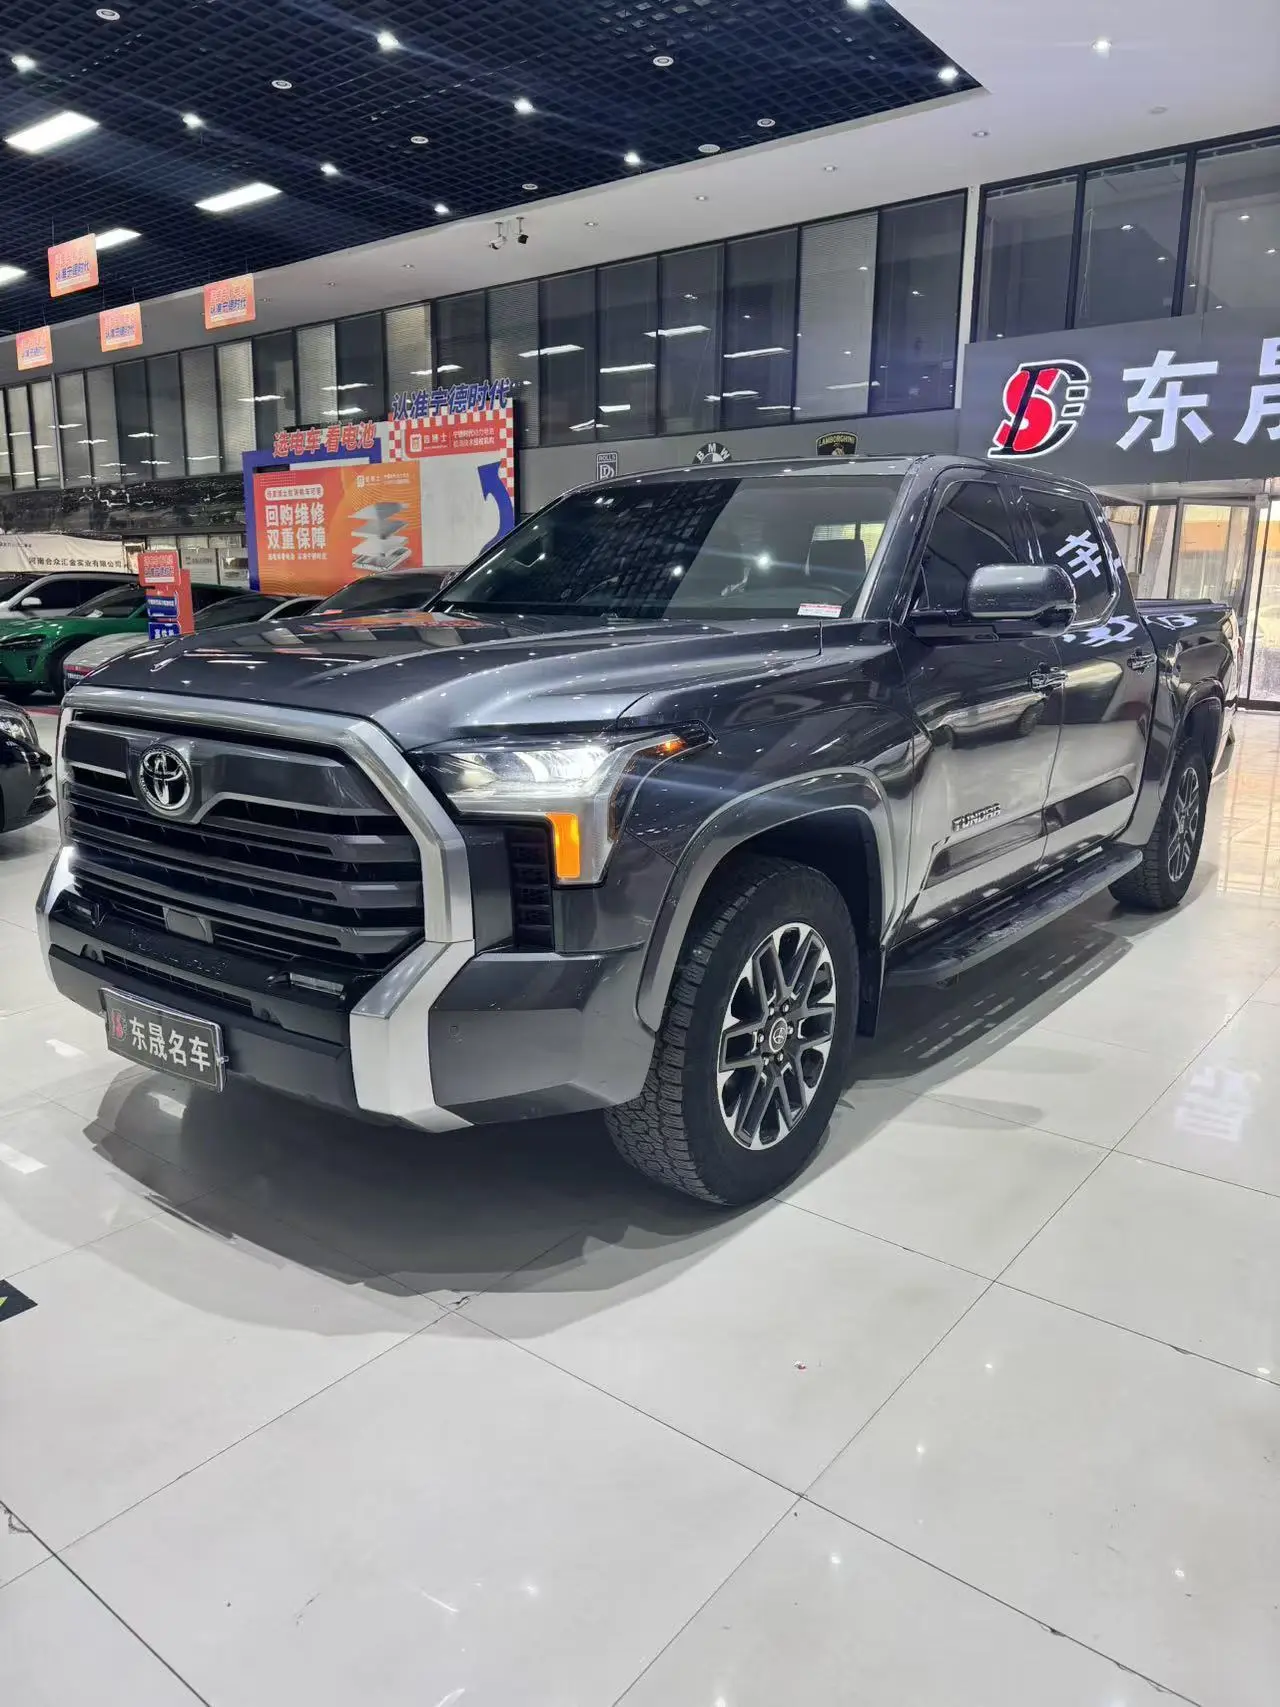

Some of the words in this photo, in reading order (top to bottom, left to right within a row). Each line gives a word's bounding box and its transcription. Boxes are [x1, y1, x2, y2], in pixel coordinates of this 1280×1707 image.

[391, 378, 511, 420] 认准宁德时代
[695, 443, 731, 462] BMW
[265, 502, 325, 527] 回购维修
[266, 526, 326, 550] 双重保障
[129, 1016, 211, 1072] 东晟名车
